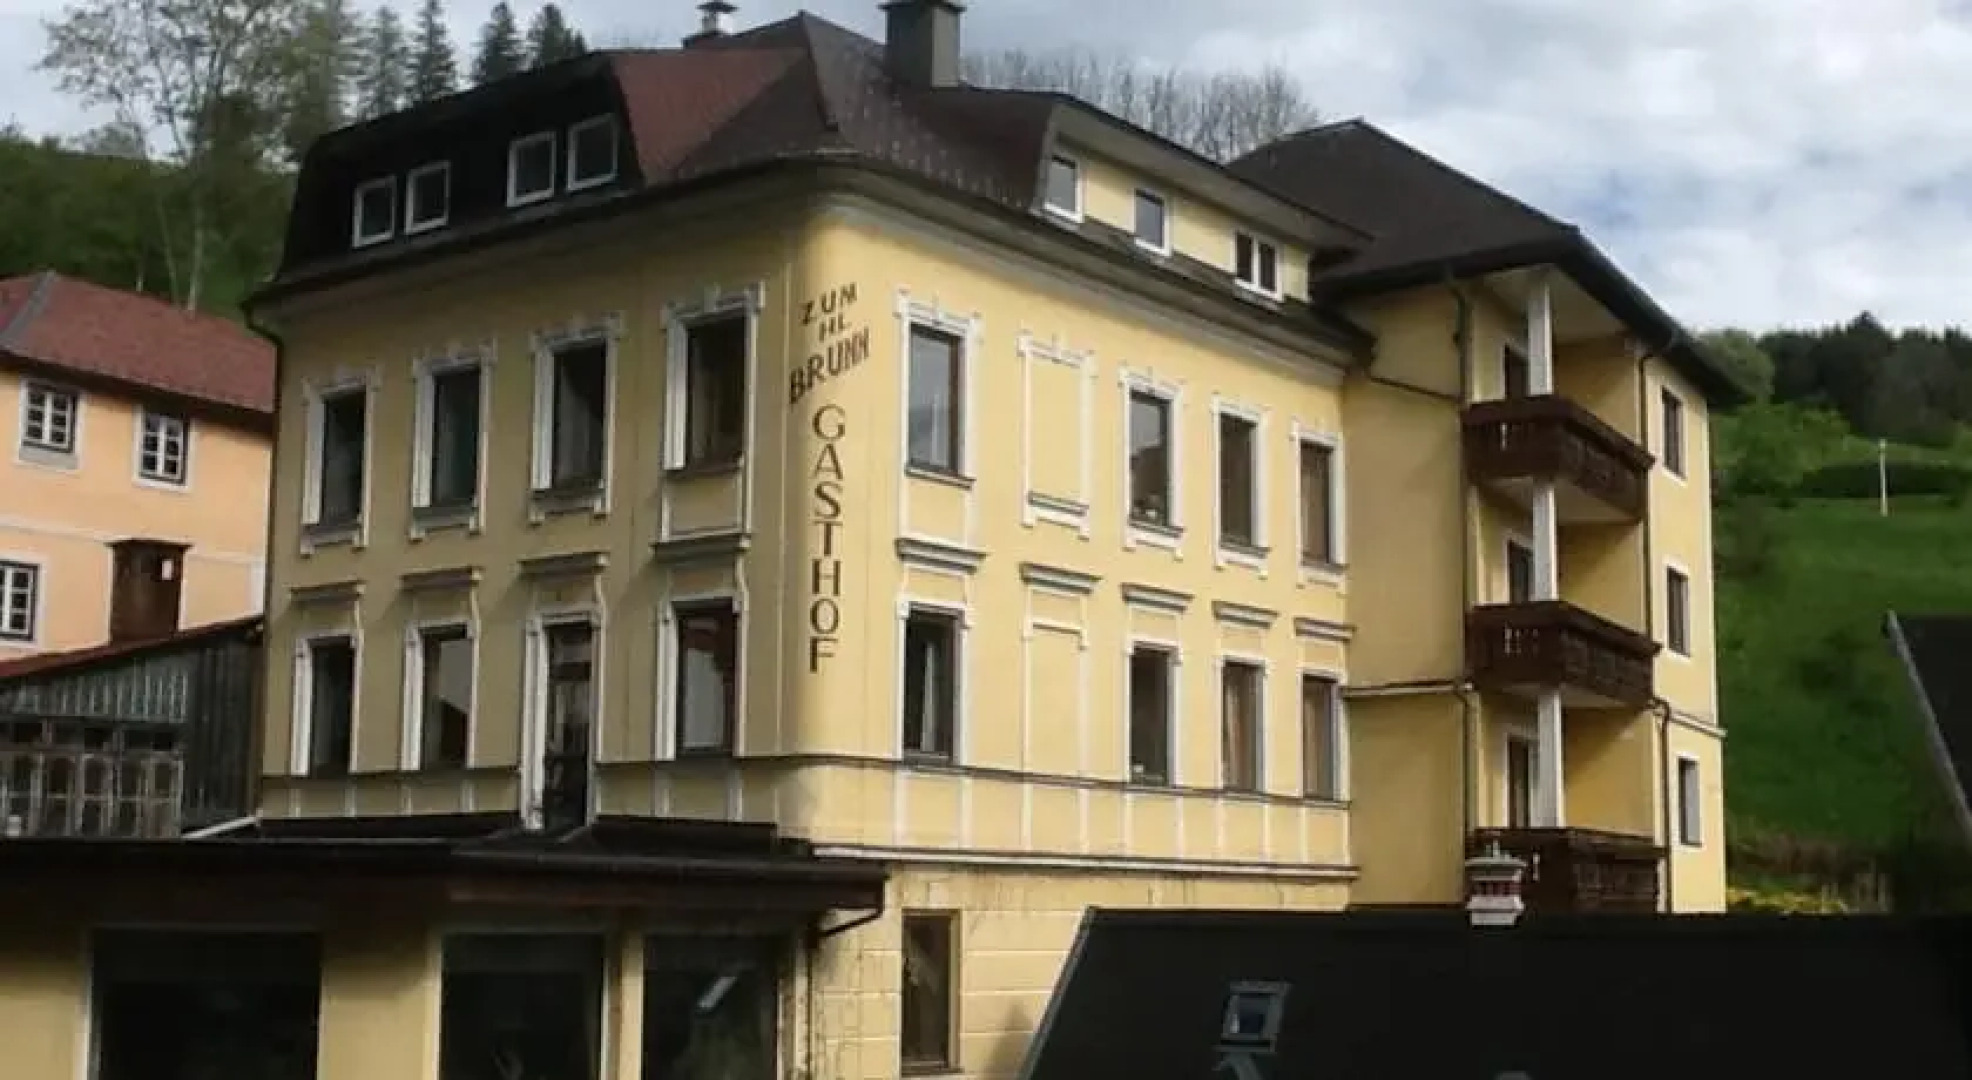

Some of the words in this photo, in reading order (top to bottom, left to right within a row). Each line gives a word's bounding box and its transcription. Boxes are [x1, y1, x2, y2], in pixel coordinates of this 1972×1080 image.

[800, 283, 857, 325] ZUM
[790, 327, 869, 404] BRUNN
[810, 404, 846, 674] GASTHOF
